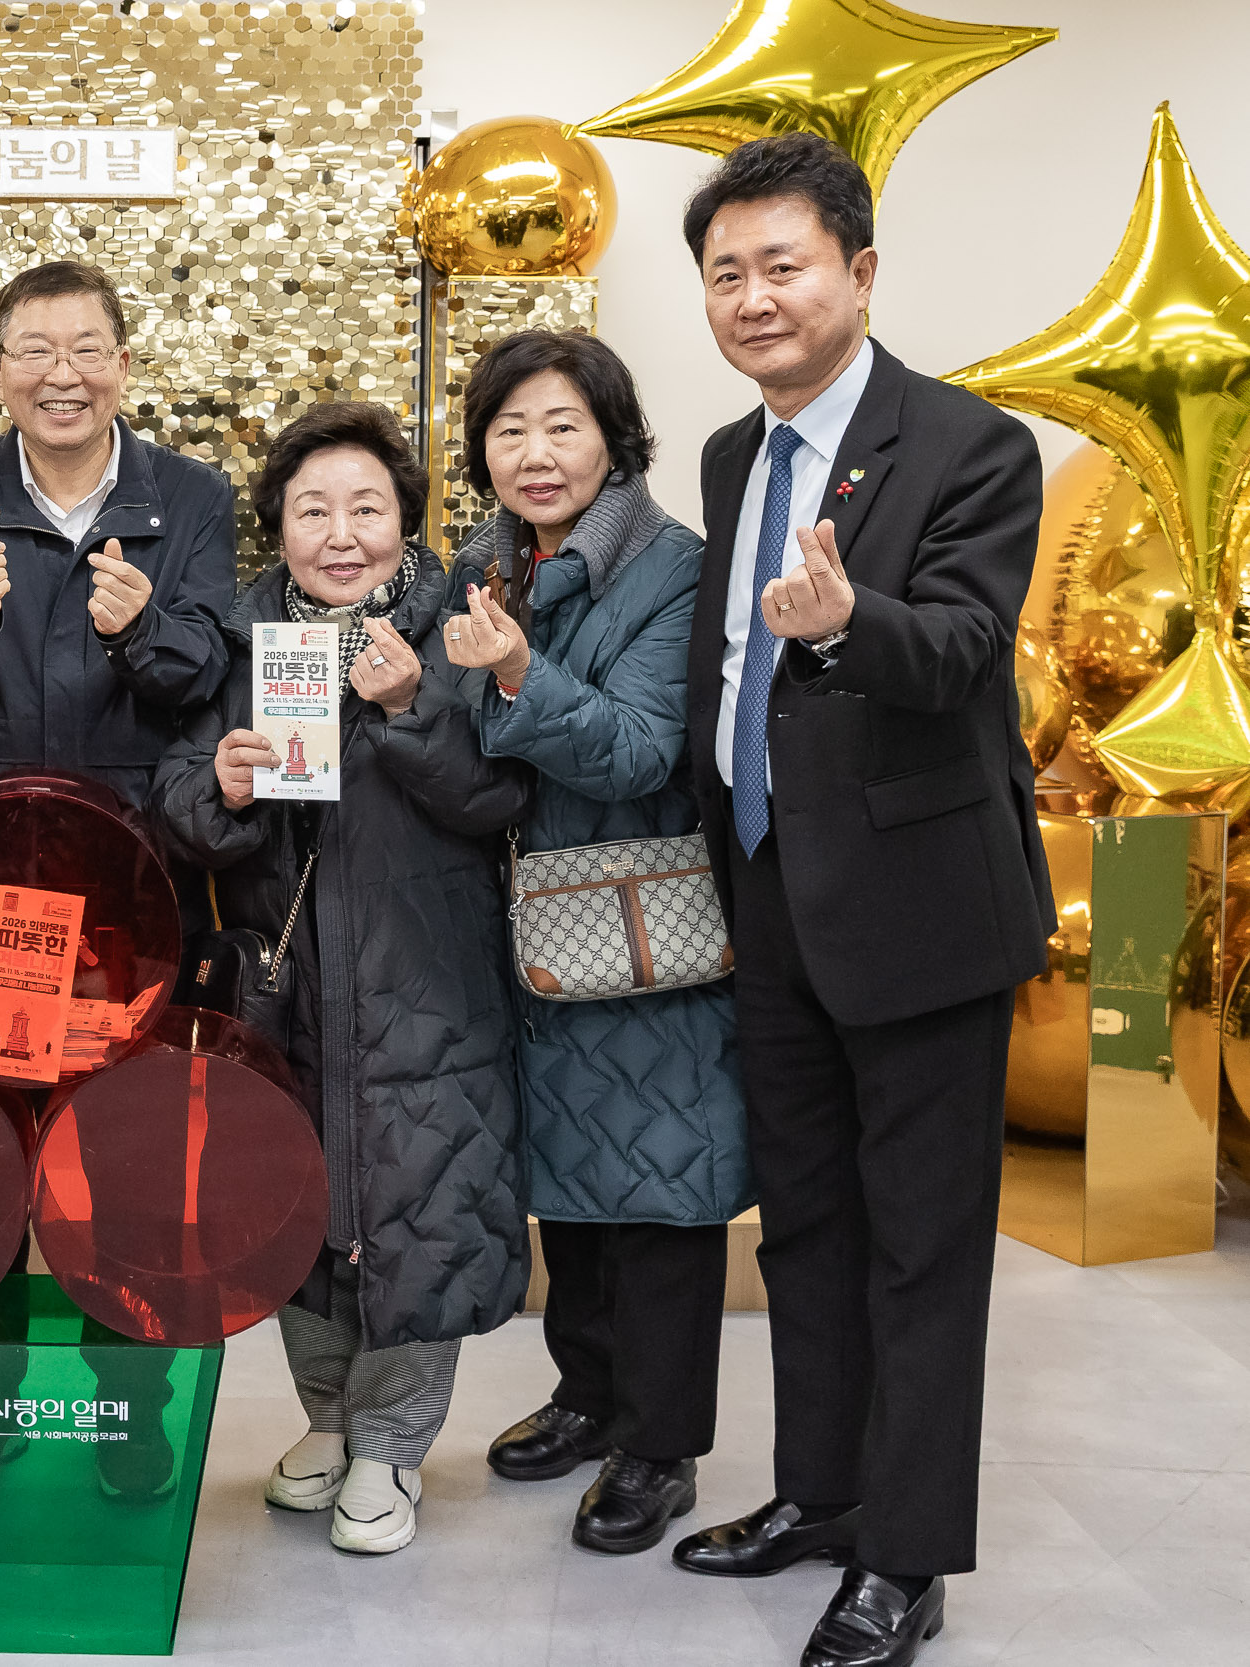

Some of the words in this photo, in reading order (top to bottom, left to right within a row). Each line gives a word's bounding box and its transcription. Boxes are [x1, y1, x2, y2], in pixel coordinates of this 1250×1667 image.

[104, 138, 146, 181] 날
[264, 651, 288, 660] 2026
[290, 651, 328, 661] 희망온돌
[263, 662, 329, 681] 따뜻한
[263, 682, 328, 696] 겨울나기
[1, 916, 27, 929] 2026
[29, 921, 70, 936] 희망온돌
[71, 1399, 130, 1428] 열매
[23, 1431, 41, 1440] 서울
[42, 1431, 129, 1443] 사회복지공동모금회
